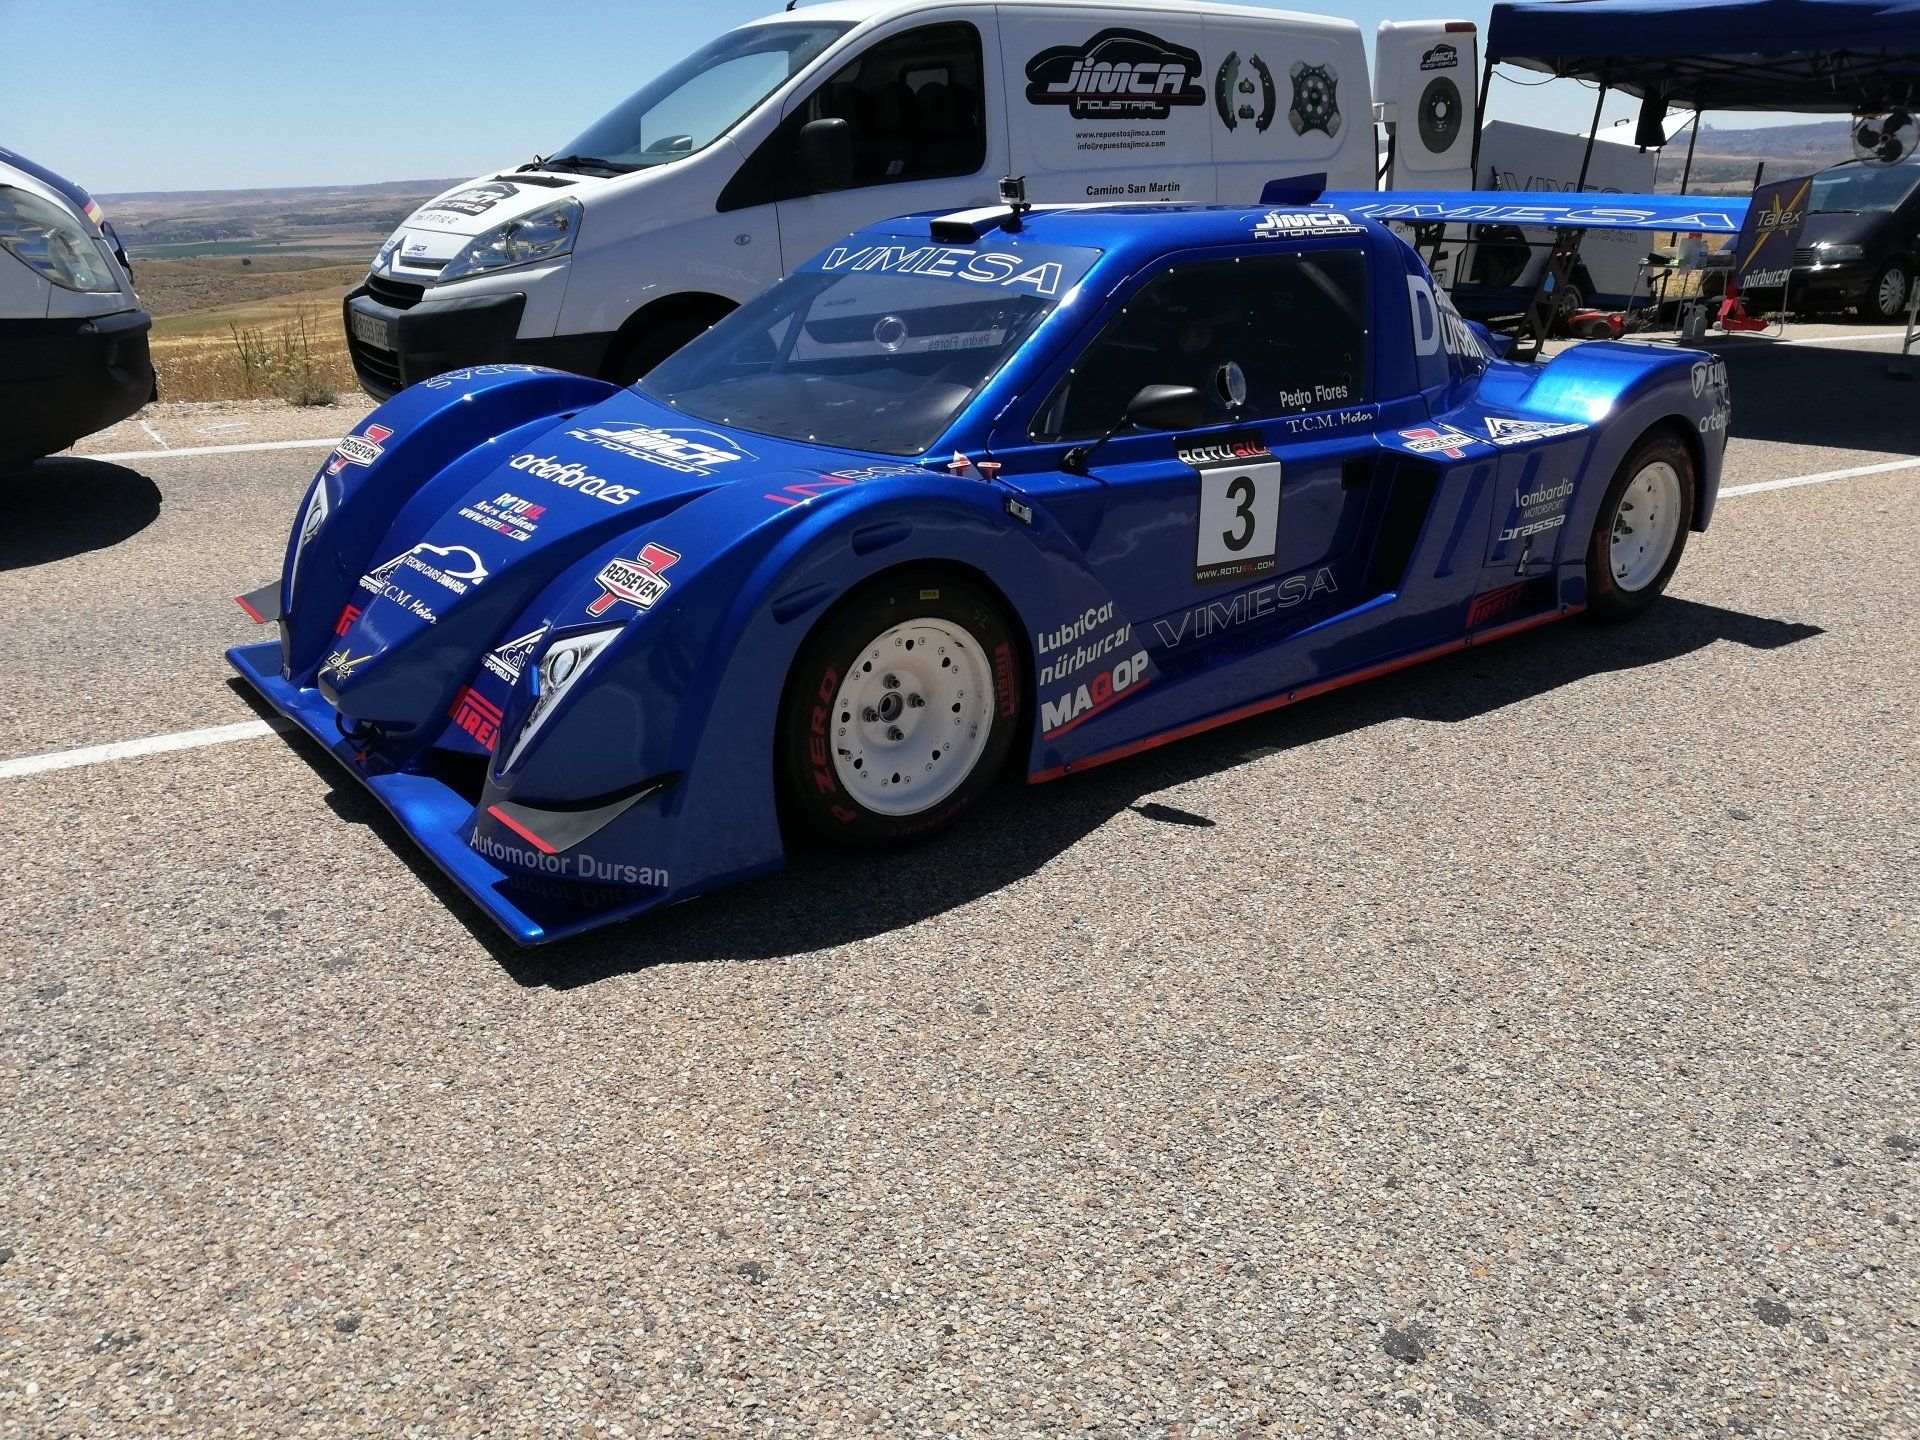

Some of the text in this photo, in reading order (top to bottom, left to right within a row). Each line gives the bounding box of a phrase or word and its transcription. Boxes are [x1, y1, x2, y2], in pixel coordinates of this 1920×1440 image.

[1075, 129, 1166, 140] www.repuestosjimca.com
[1077, 140, 1166, 151] info@repuestosjimca.com
[1086, 184, 1125, 196] Camino
[1127, 183, 1147, 194] San
[1757, 209, 1803, 227] Talex
[821, 246, 1063, 295] VIMESA
[1279, 384, 1348, 408] Pedro Flores
[1286, 411, 1373, 434] T.C.M. Motor
[339, 438, 379, 461] REDSEVEN
[509, 453, 641, 505] artefibra.es
[1515, 477, 1574, 508] lombardia
[1222, 475, 1256, 552] 3
[1523, 499, 1565, 519] MOTORSPORT
[403, 555, 427, 572] TECNO
[421, 565, 443, 580] CARS
[602, 562, 664, 600] REDSEVEN
[1196, 560, 1275, 581] WWW.ROTUSIL.COM
[408, 598, 438, 625] Motor
[1152, 566, 1339, 649] VIMESA
[1037, 600, 1113, 655] LubriCar
[327, 650, 356, 677] Talex
[1039, 622, 1131, 687] nürburcar
[469, 826, 670, 888] Automotor Dursan
